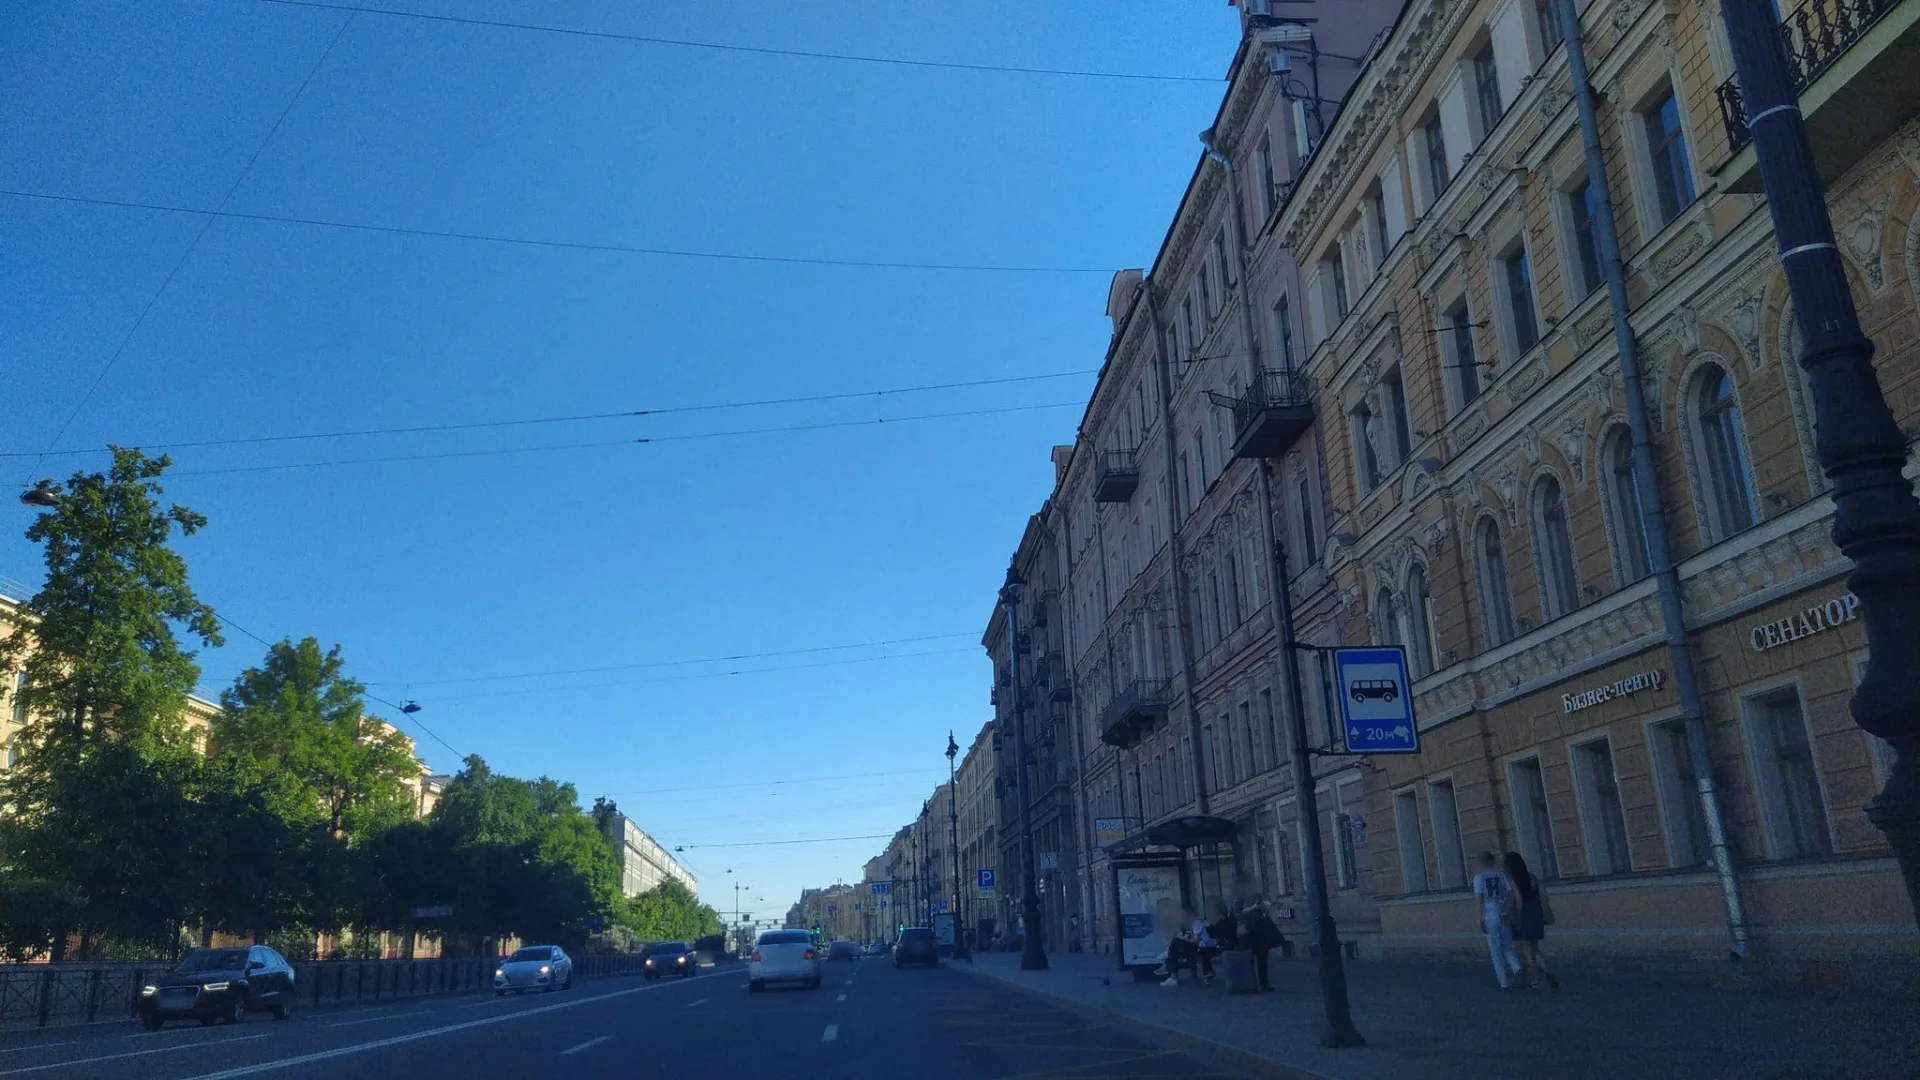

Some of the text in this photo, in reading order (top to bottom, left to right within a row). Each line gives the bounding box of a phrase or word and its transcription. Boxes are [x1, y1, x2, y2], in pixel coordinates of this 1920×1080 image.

[1750, 593, 1859, 652] СЕНАТОР
[1561, 667, 1661, 714] Бизнес-центр
[982, 871, 992, 885] P
